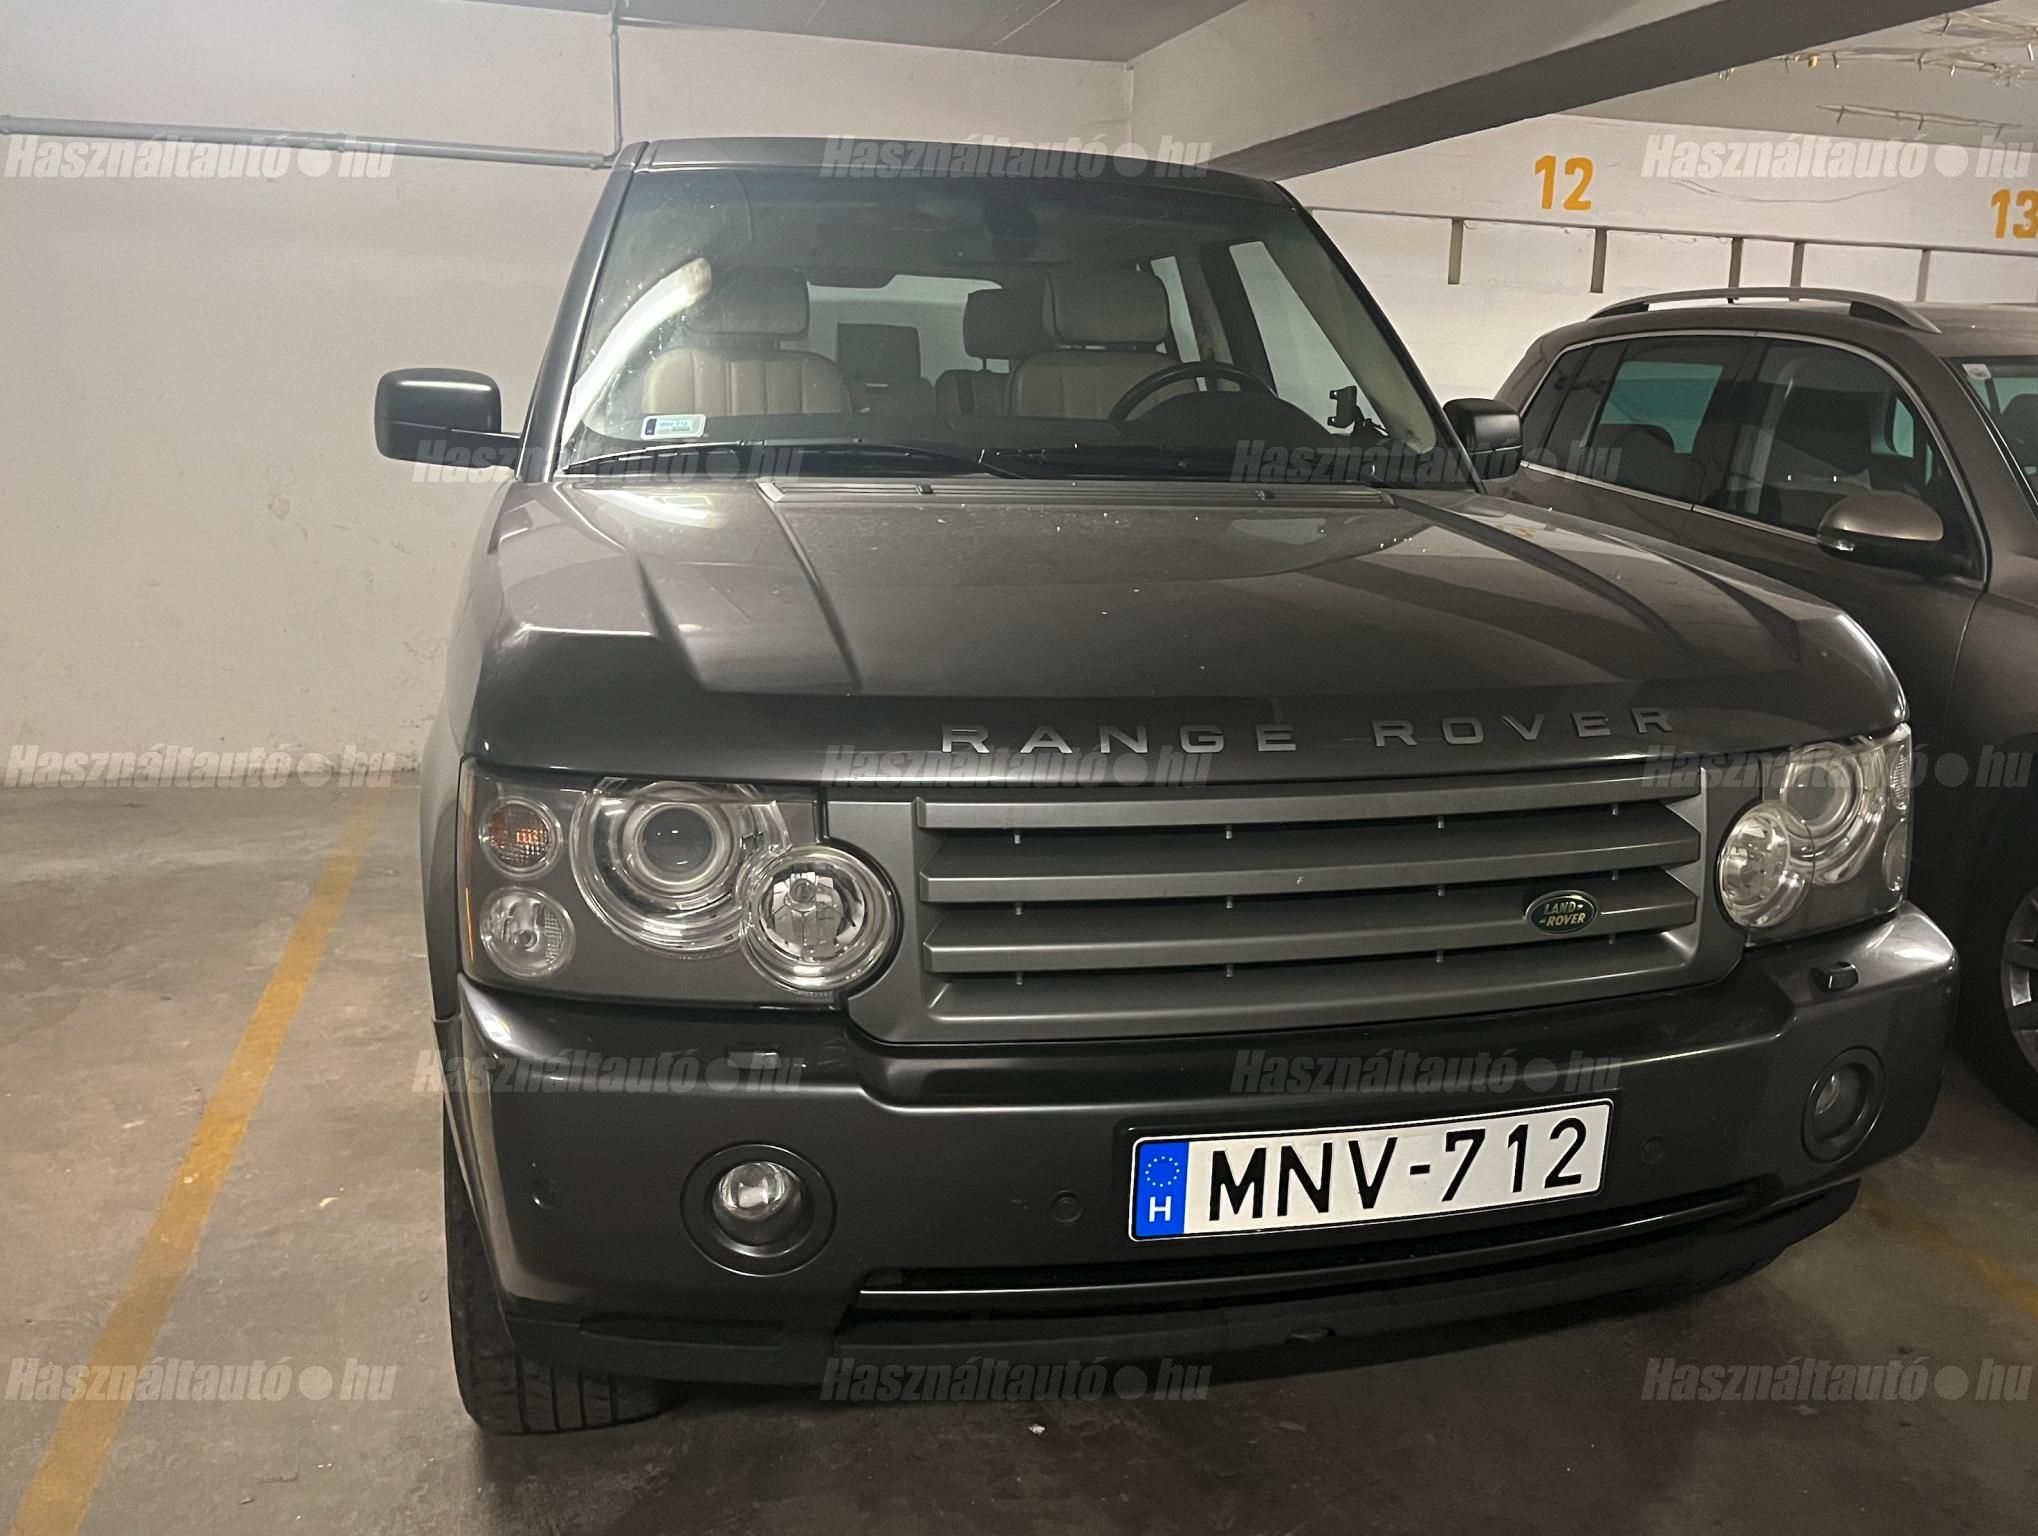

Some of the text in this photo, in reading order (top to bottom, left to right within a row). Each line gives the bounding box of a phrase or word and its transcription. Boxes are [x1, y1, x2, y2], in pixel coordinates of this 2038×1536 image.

[1535, 155, 1593, 210] 12
[1991, 188, 2038, 239] 13
[942, 707, 1673, 753] RANGE ROVER
[1209, 1117, 1588, 1221] MNV-712
[1148, 1196, 1172, 1223] H
